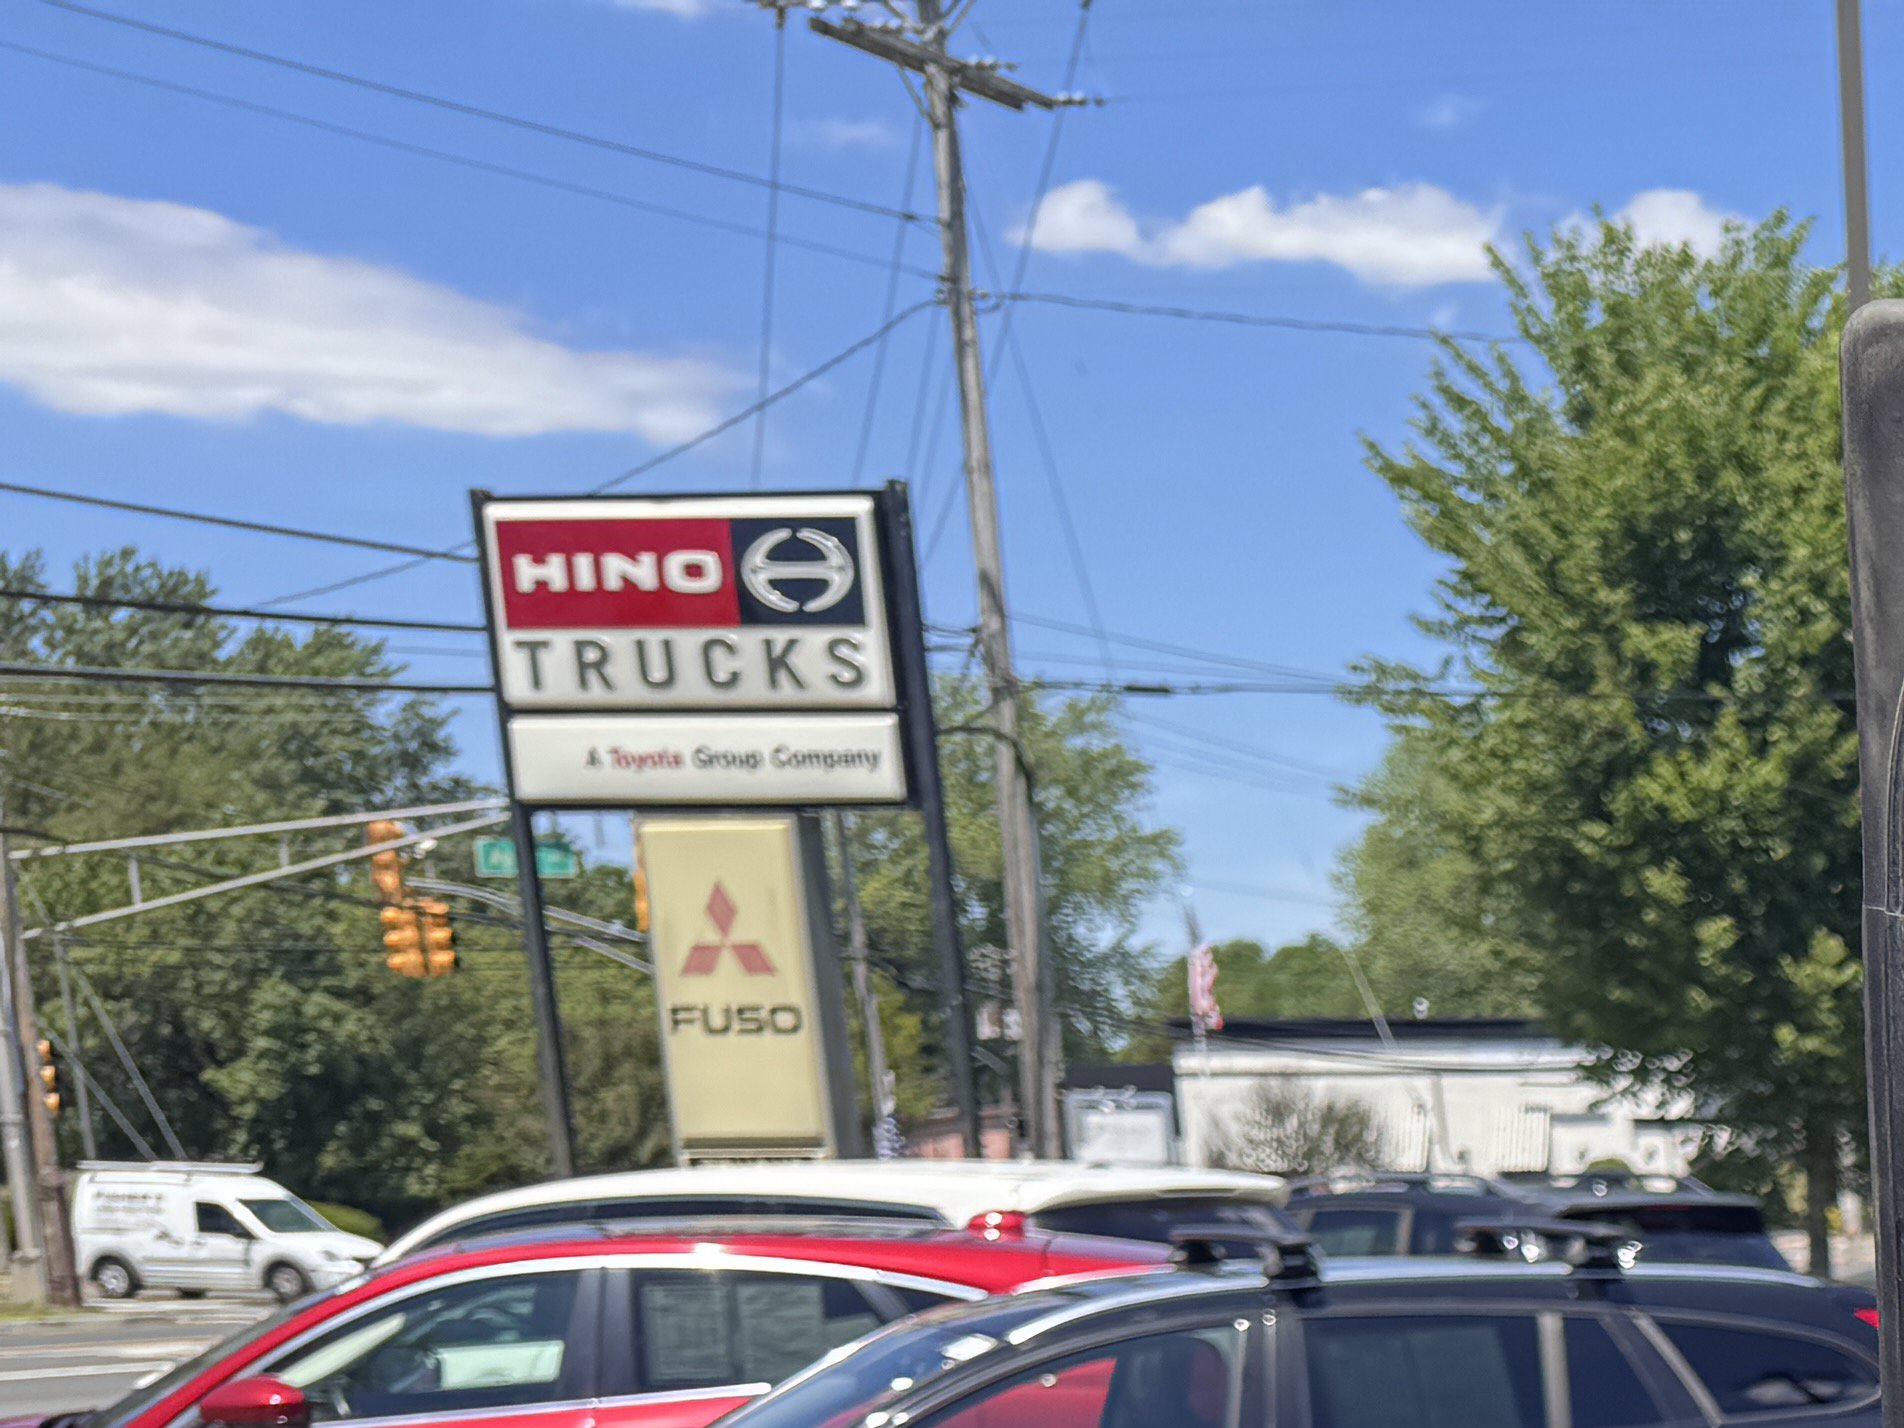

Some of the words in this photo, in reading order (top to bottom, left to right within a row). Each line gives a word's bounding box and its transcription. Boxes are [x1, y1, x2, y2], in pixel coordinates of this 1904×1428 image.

[511, 549, 723, 594] HINO
[513, 637, 868, 692] TRUCKS
[585, 748, 602, 769] A
[608, 747, 683, 773] Toyota
[691, 746, 763, 772] Group
[769, 746, 881, 774] Company
[670, 1002, 803, 1036] FUSO
